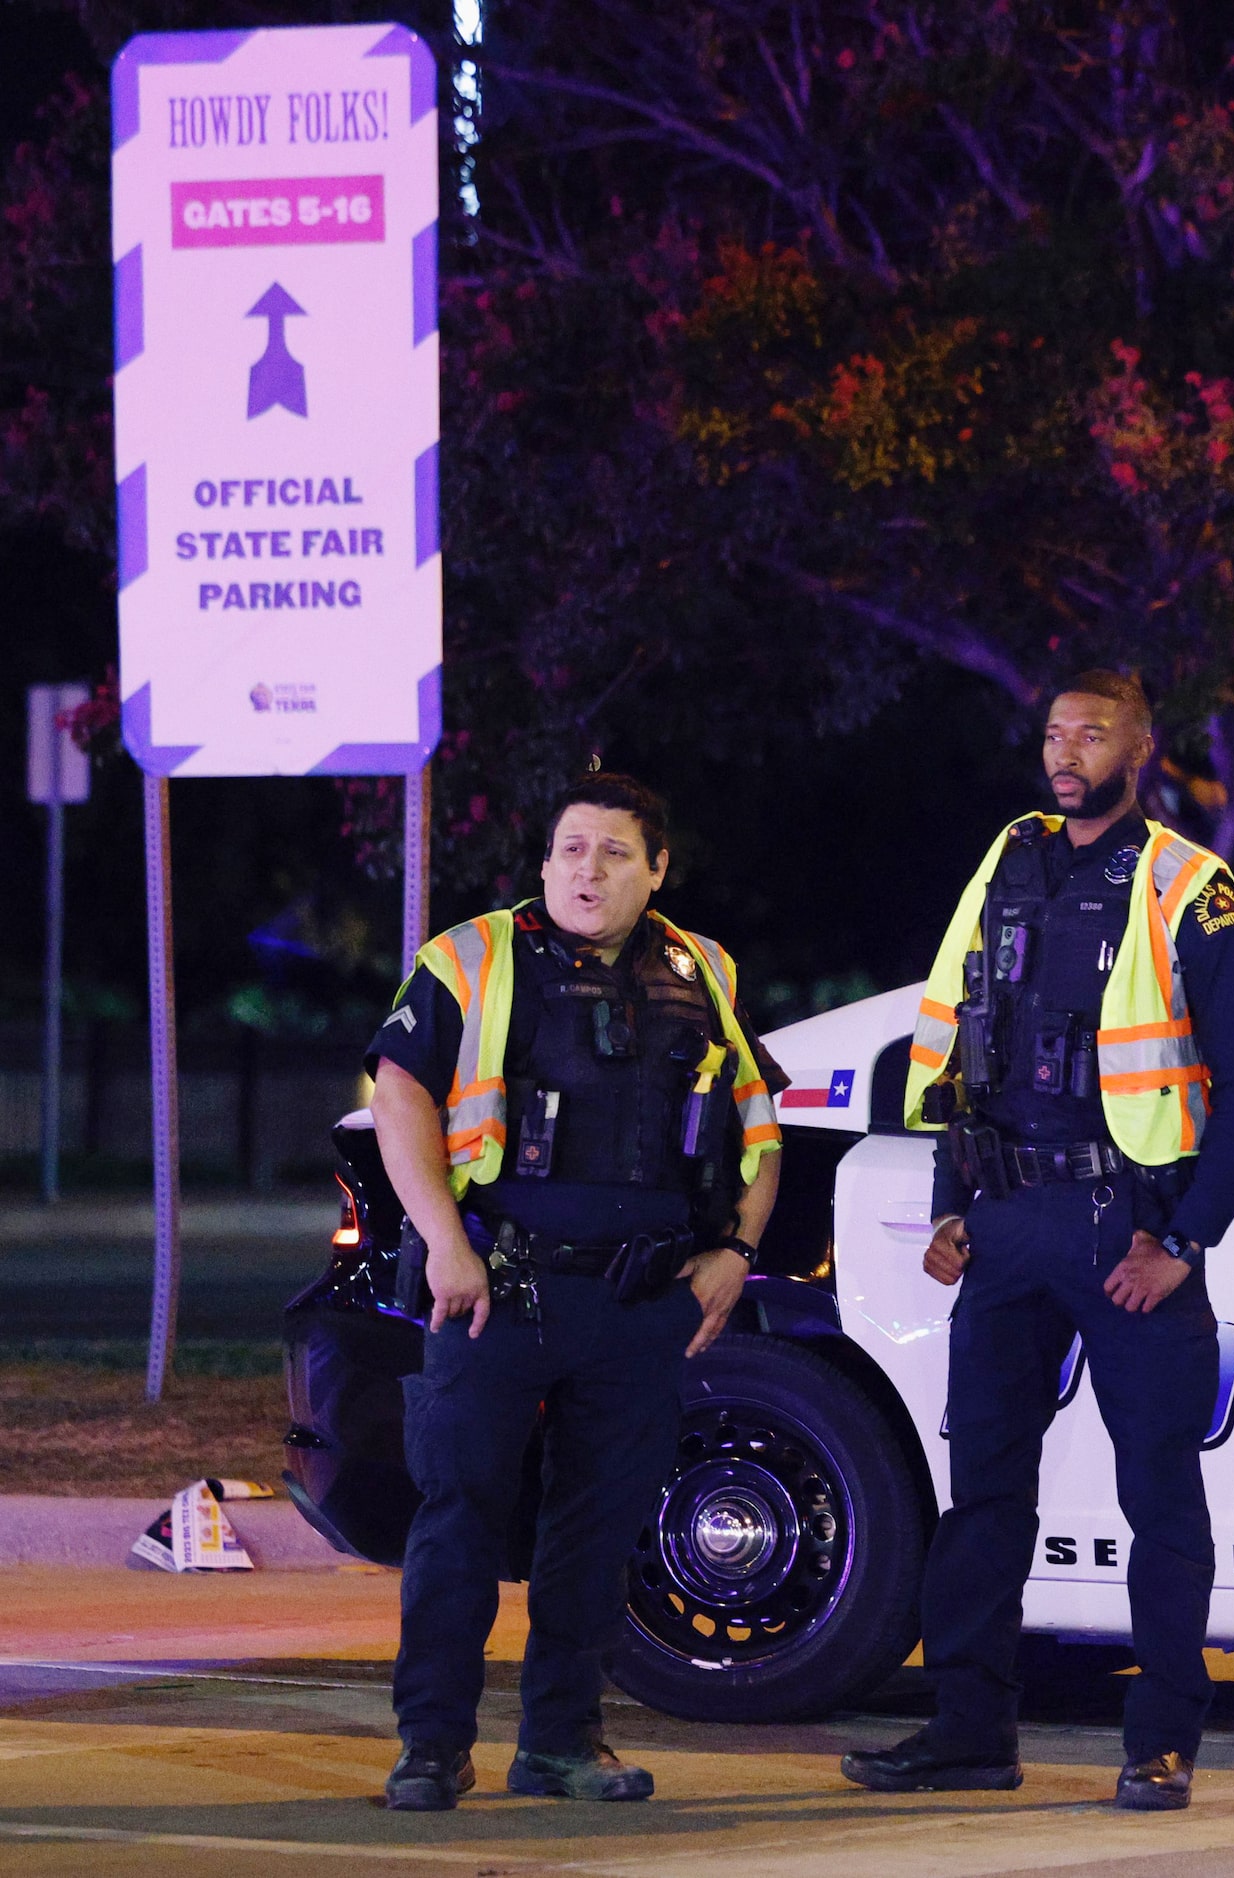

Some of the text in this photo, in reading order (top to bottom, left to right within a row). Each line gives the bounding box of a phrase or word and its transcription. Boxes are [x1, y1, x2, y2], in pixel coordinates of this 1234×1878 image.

[168, 90, 389, 148] HOWDY FOLKS!
[183, 194, 372, 230] GATES 5-16
[194, 477, 364, 508] OFFICIAL
[175, 527, 384, 560] STATE FAIR
[199, 580, 362, 610] PARKING
